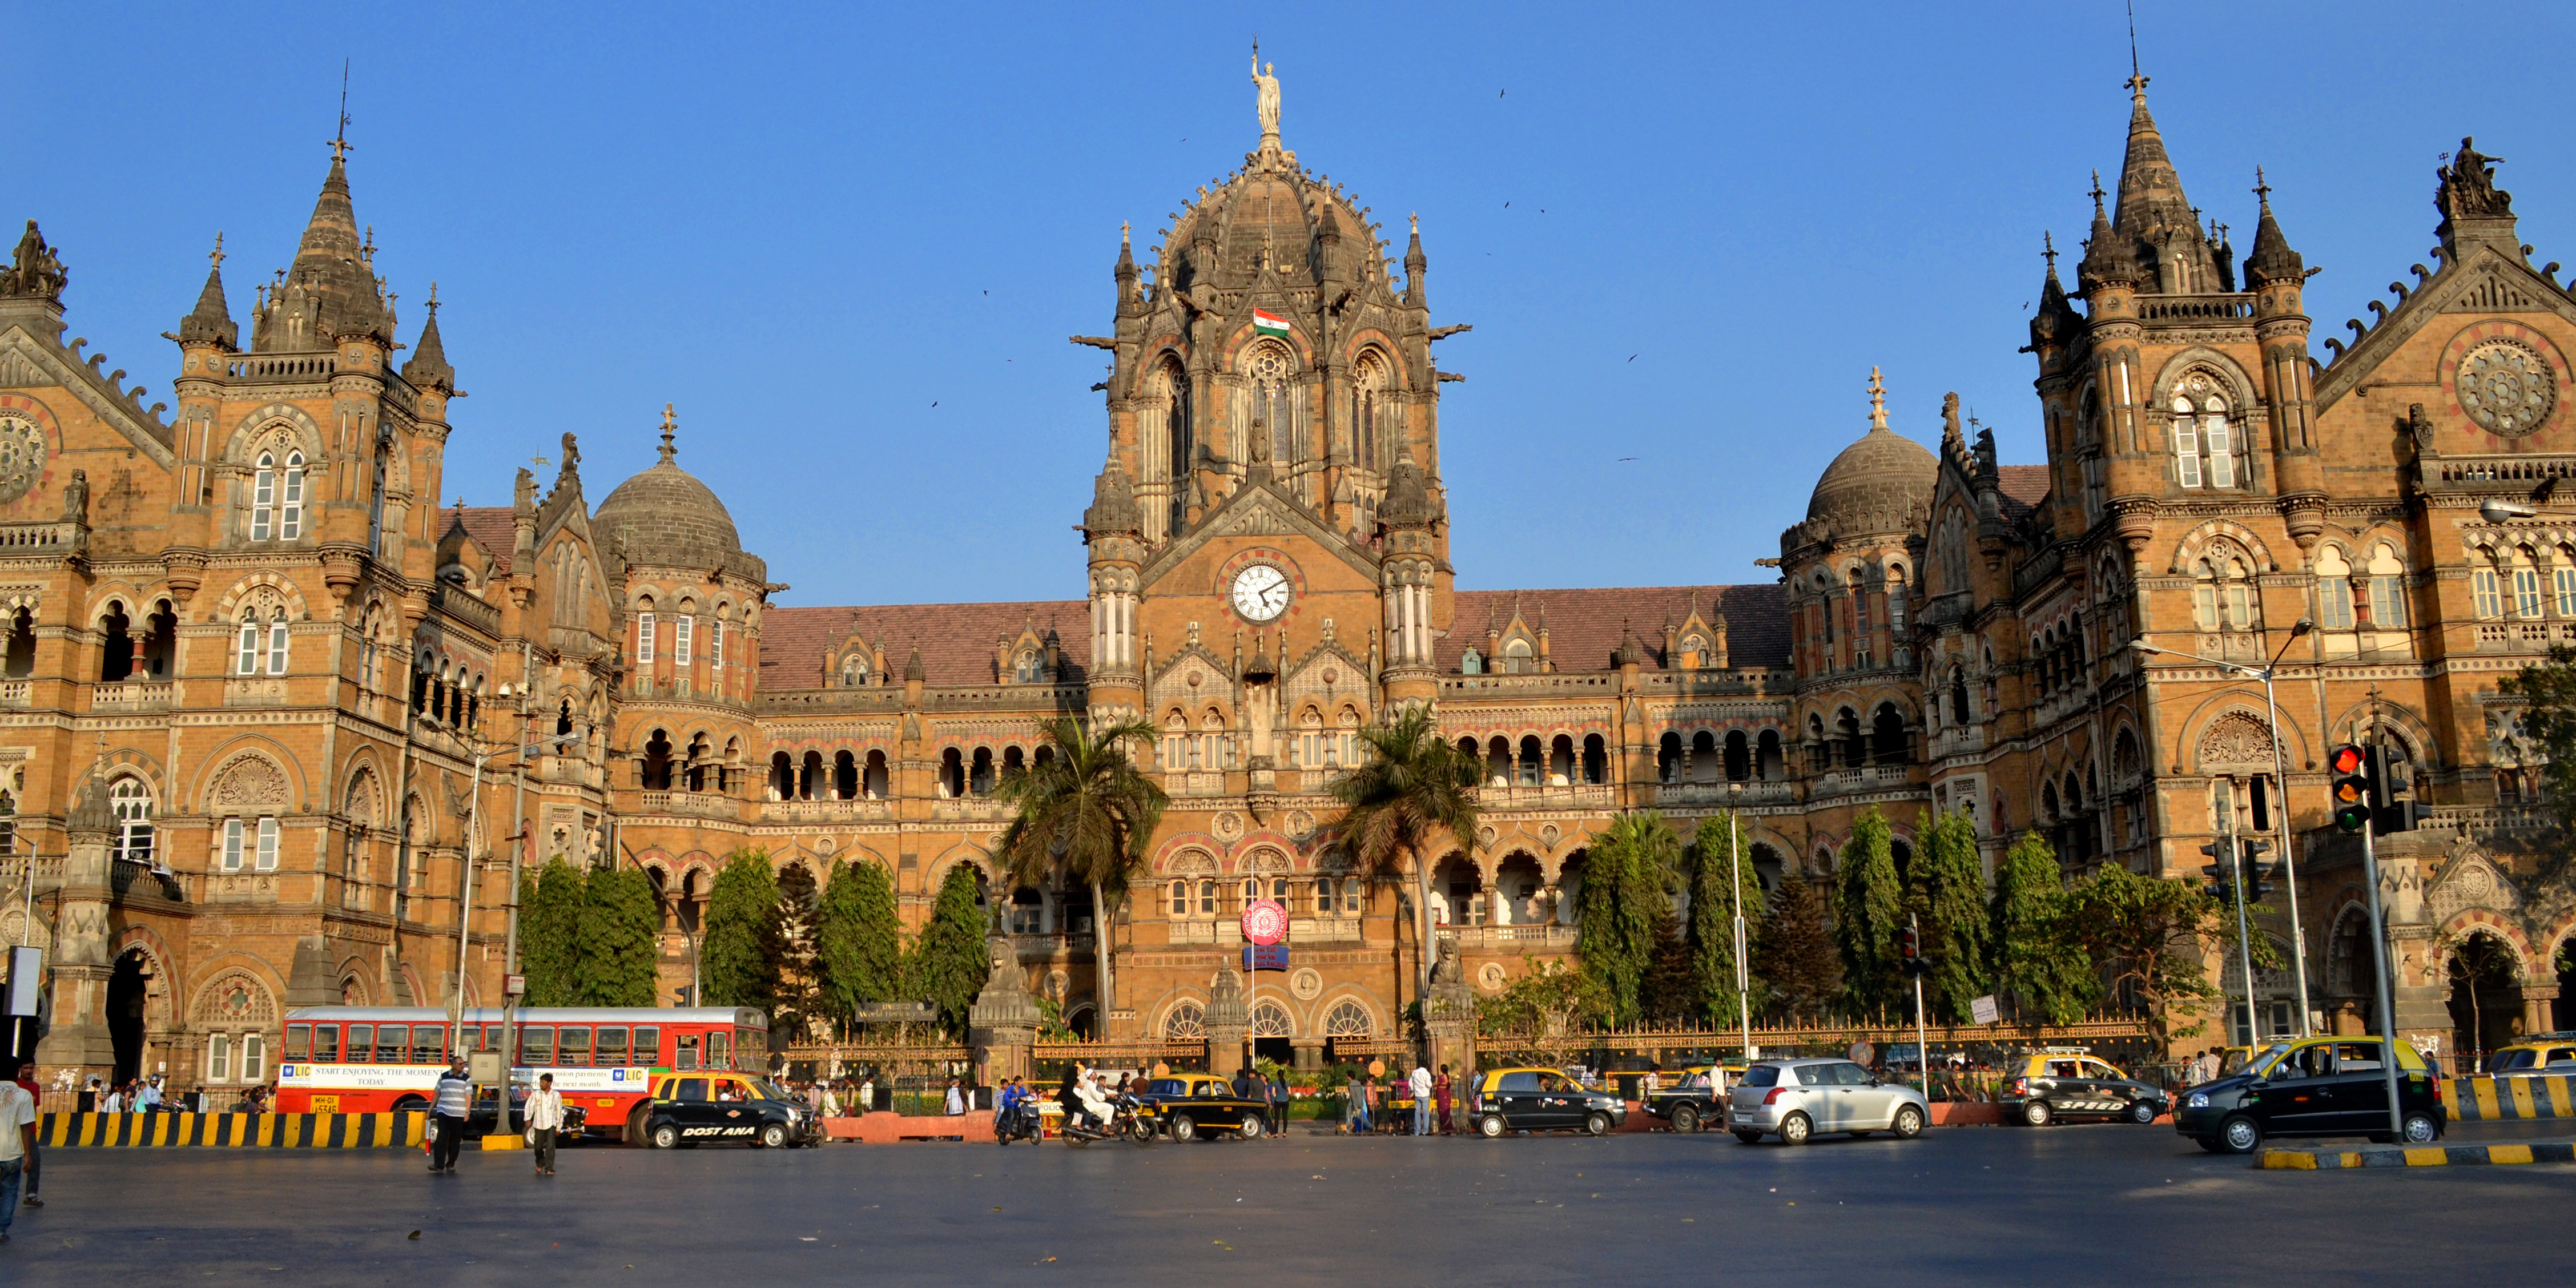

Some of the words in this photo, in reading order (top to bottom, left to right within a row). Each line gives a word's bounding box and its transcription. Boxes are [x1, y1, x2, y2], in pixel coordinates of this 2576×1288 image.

[1259, 901, 1279, 911] INDIAN
[1273, 910, 1285, 940] RAILWAYS
[859, 1009, 883, 1017] World
[295, 1066, 311, 1076] LIC
[342, 1068, 384, 1076] ENJOYING
[626, 1070, 642, 1080] LIC
[2059, 1101, 2124, 1110] SPEED
[682, 1127, 723, 1137] DOST
[721, 1126, 755, 1136] ANA
